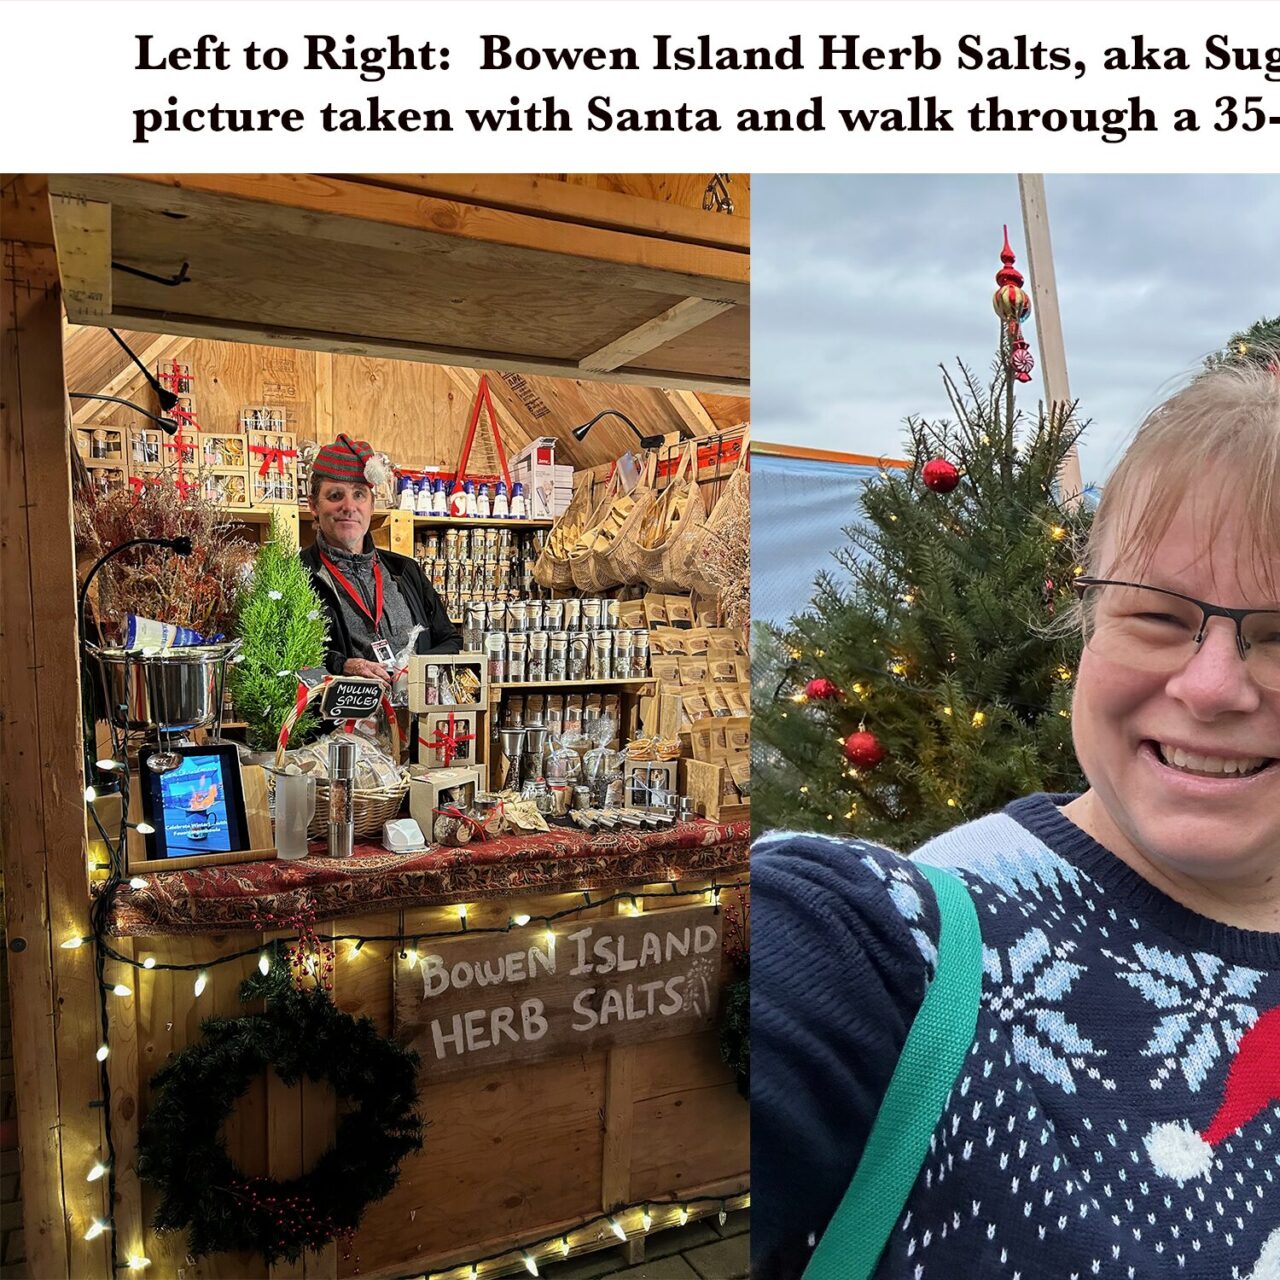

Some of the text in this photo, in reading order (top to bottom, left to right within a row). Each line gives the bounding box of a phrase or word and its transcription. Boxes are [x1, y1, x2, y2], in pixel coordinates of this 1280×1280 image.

[336, 684, 379, 697] MULLING
[419, 925, 718, 1000] BOWEN ISLAND
[430, 975, 687, 1060] HERB SALTS
